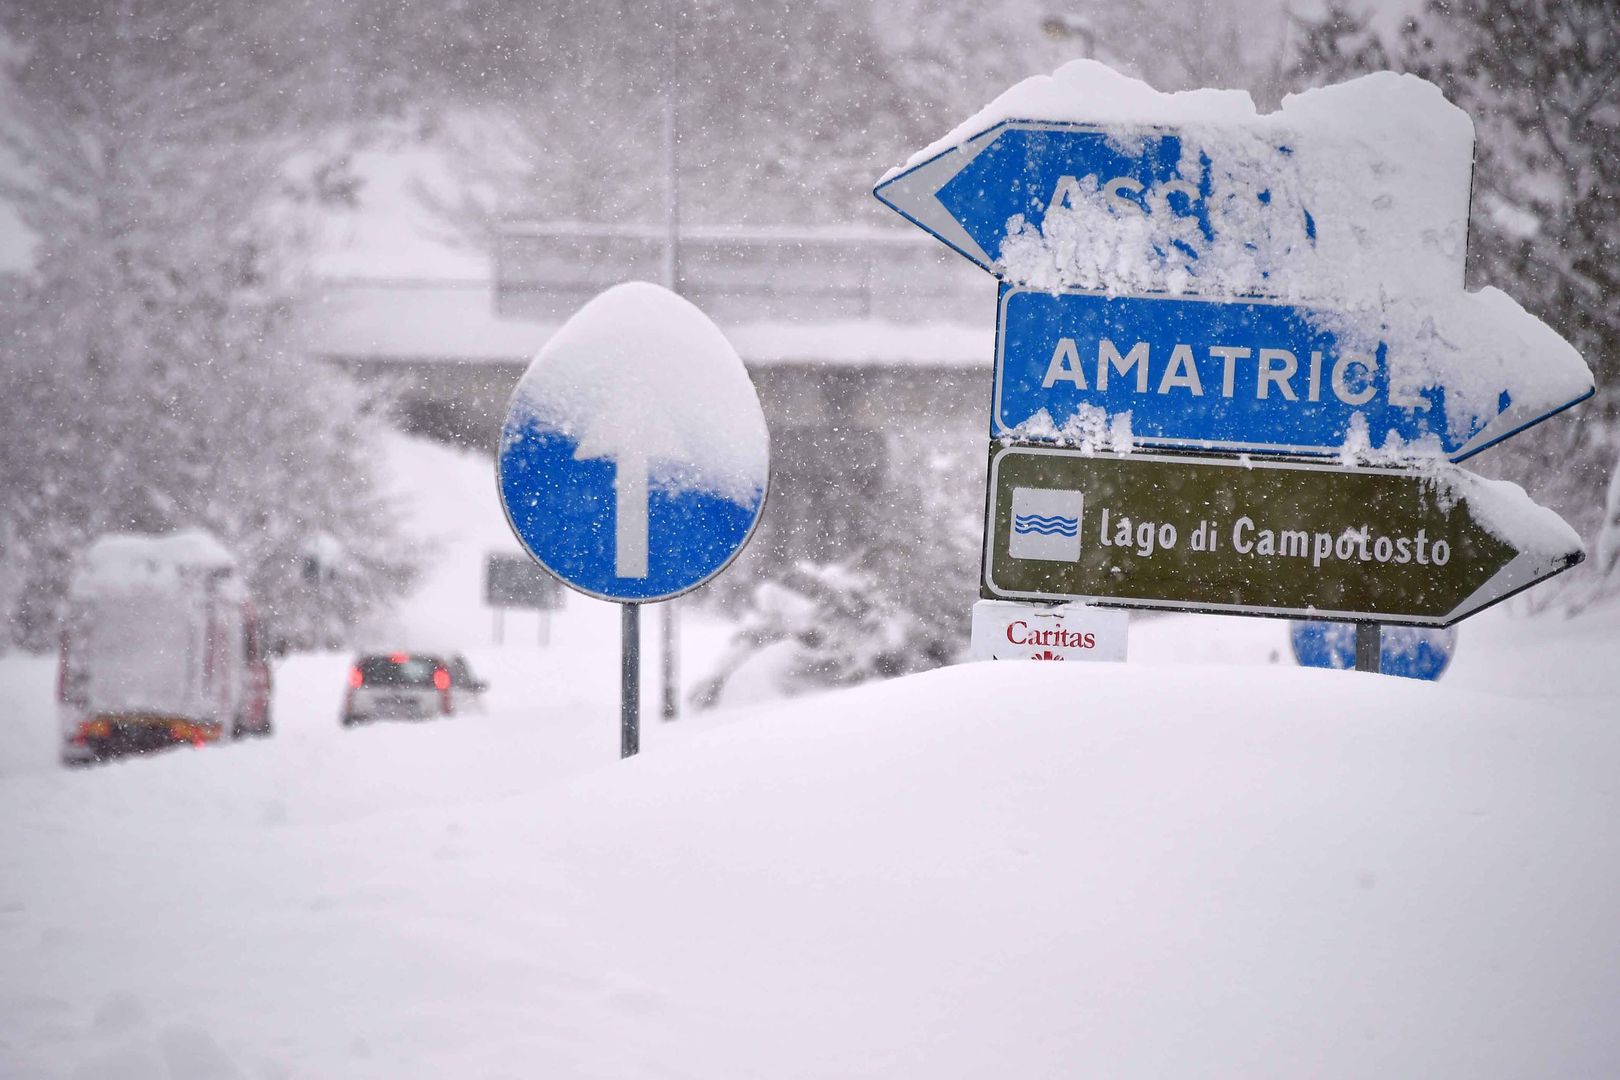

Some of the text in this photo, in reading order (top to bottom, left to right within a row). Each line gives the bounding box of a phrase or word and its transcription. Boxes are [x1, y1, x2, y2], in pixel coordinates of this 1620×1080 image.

[1191, 520, 1217, 551] di
[1233, 516, 1450, 567] Campotosto
[1006, 620, 1096, 648] Caritas
